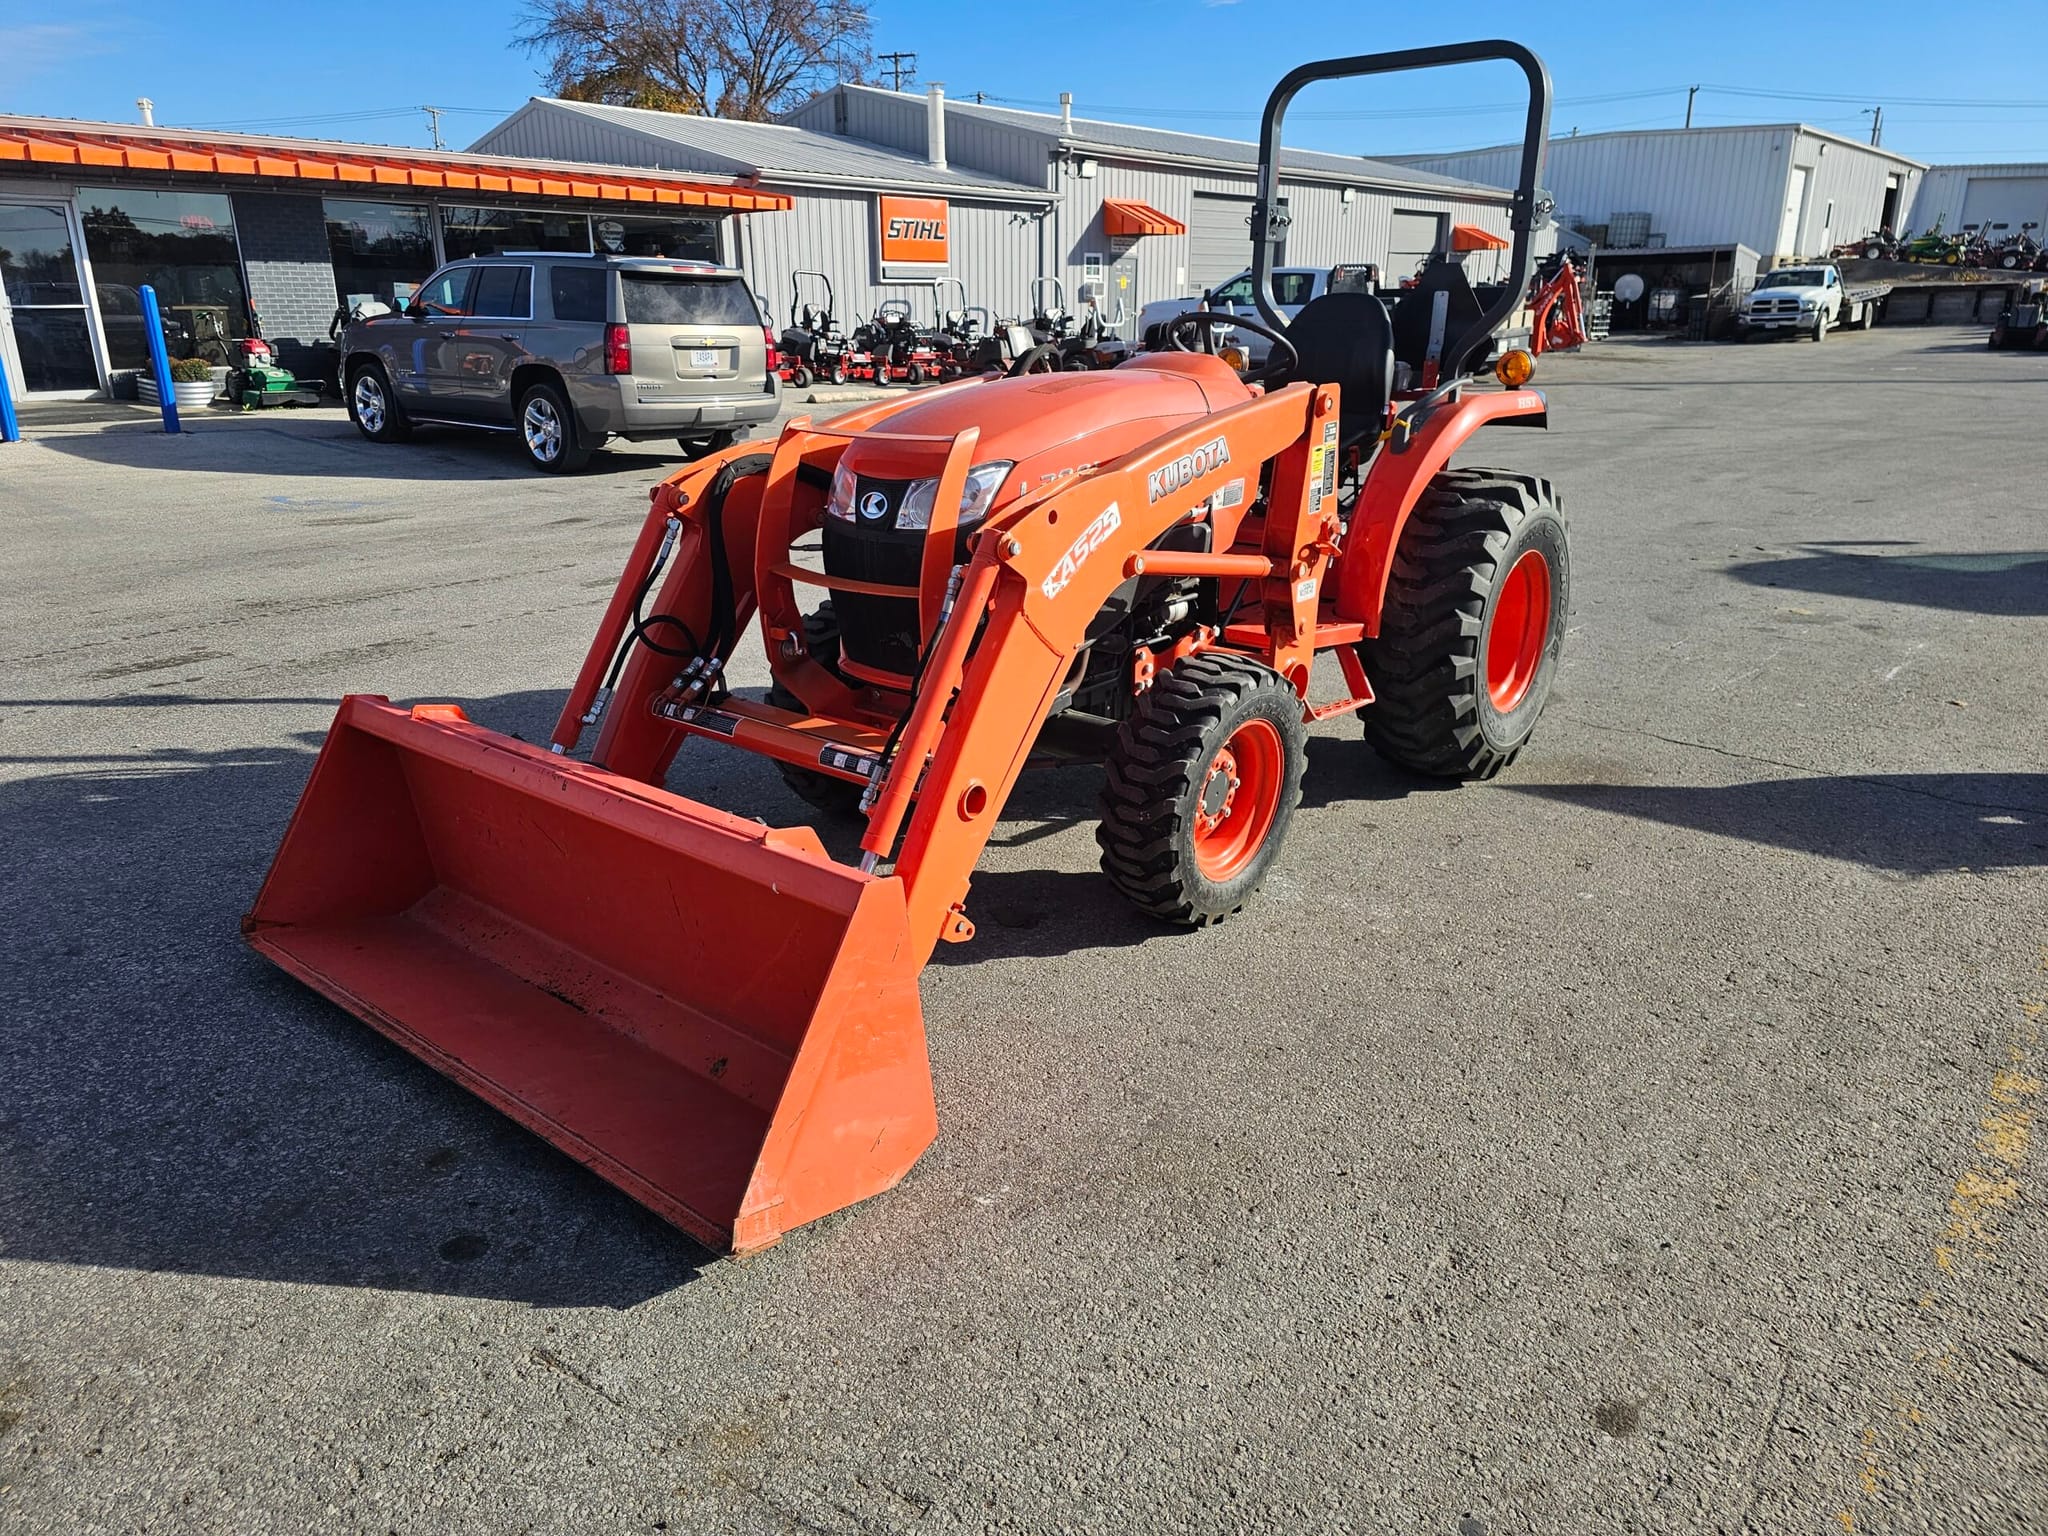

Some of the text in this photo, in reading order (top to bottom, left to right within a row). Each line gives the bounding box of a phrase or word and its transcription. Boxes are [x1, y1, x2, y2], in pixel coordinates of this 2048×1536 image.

[180, 215, 213, 228] OPEN
[887, 217, 945, 240] STIHL
[1148, 439, 1230, 505] KUBOTA
